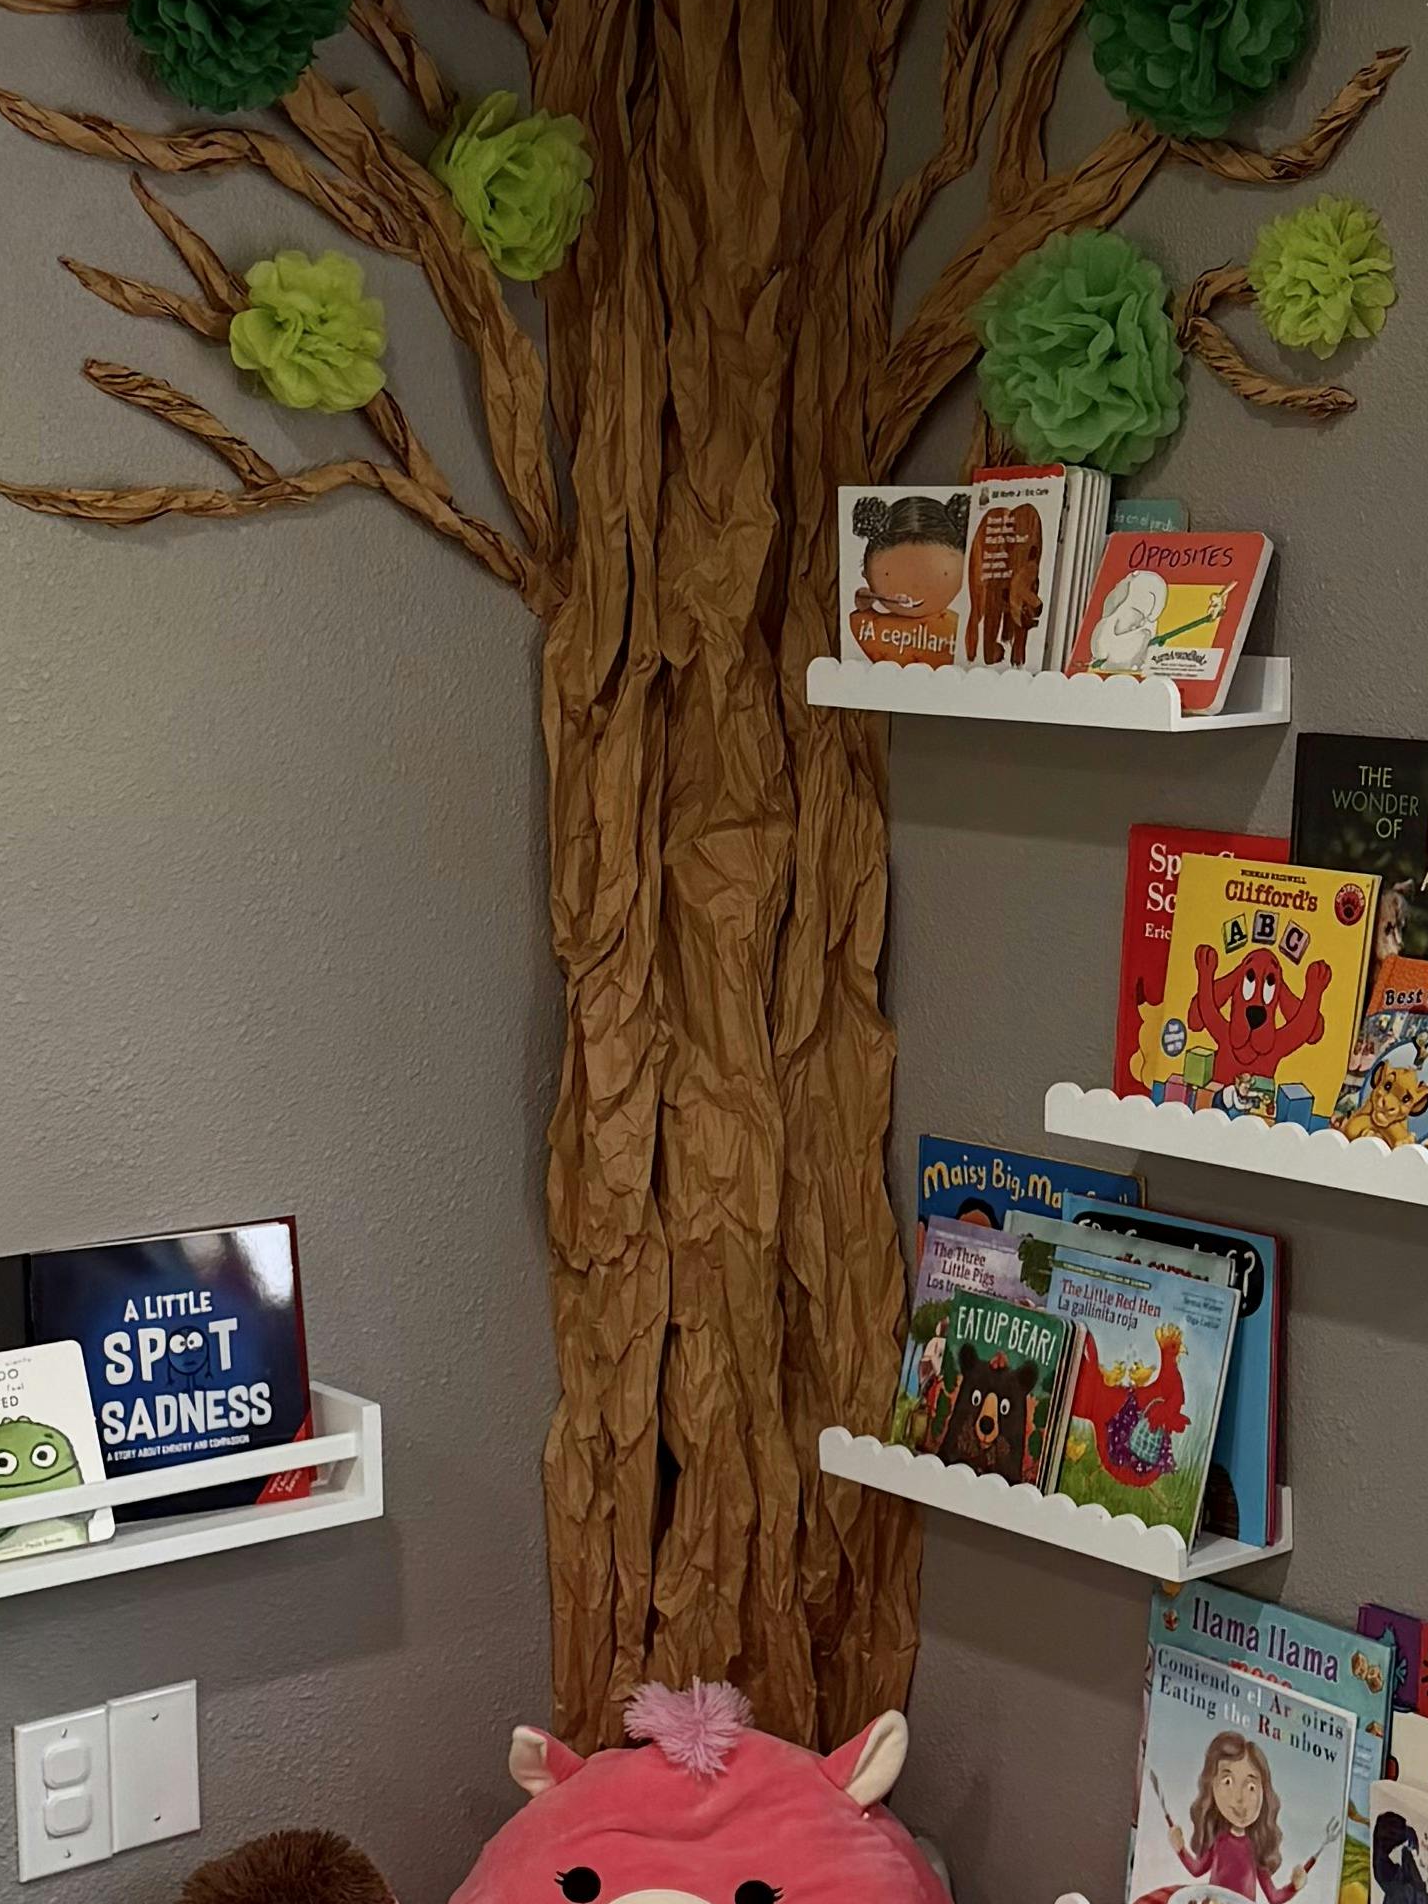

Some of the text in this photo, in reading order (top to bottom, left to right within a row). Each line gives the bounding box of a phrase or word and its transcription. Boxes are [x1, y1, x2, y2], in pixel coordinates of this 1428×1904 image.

[1129, 539, 1233, 568] OPPOSITES
[1359, 765, 1393, 788] THE
[1332, 789, 1420, 817] WONDER
[1376, 817, 1403, 840] OF
[1225, 879, 1318, 912] Clifford's
[1384, 989, 1423, 1006] Best
[923, 1154, 987, 1199] Maisy
[934, 1240, 954, 1259] The
[956, 1247, 987, 1267] Three
[927, 1274, 944, 1291] Los
[941, 1260, 995, 1288] Little Pigs
[124, 1291, 213, 1323] A LITTLE
[1058, 1295, 1139, 1331] La gallinita roja
[1062, 1278, 1082, 1297] The
[1083, 1284, 1114, 1306] Little
[1115, 1292, 1137, 1311] Red
[1138, 1300, 1162, 1318] Hen
[956, 1306, 985, 1341] EAT
[1008, 1317, 1057, 1367] BEAR!
[101, 1382, 272, 1445] SADNESS
[1192, 1597, 1261, 1653] llama
[1267, 1624, 1339, 1684] llama
[1158, 1648, 1241, 1698] Comiendo
[1247, 1688, 1262, 1708] el
[1160, 1674, 1217, 1720] Eating
[1224, 1702, 1251, 1728] the
